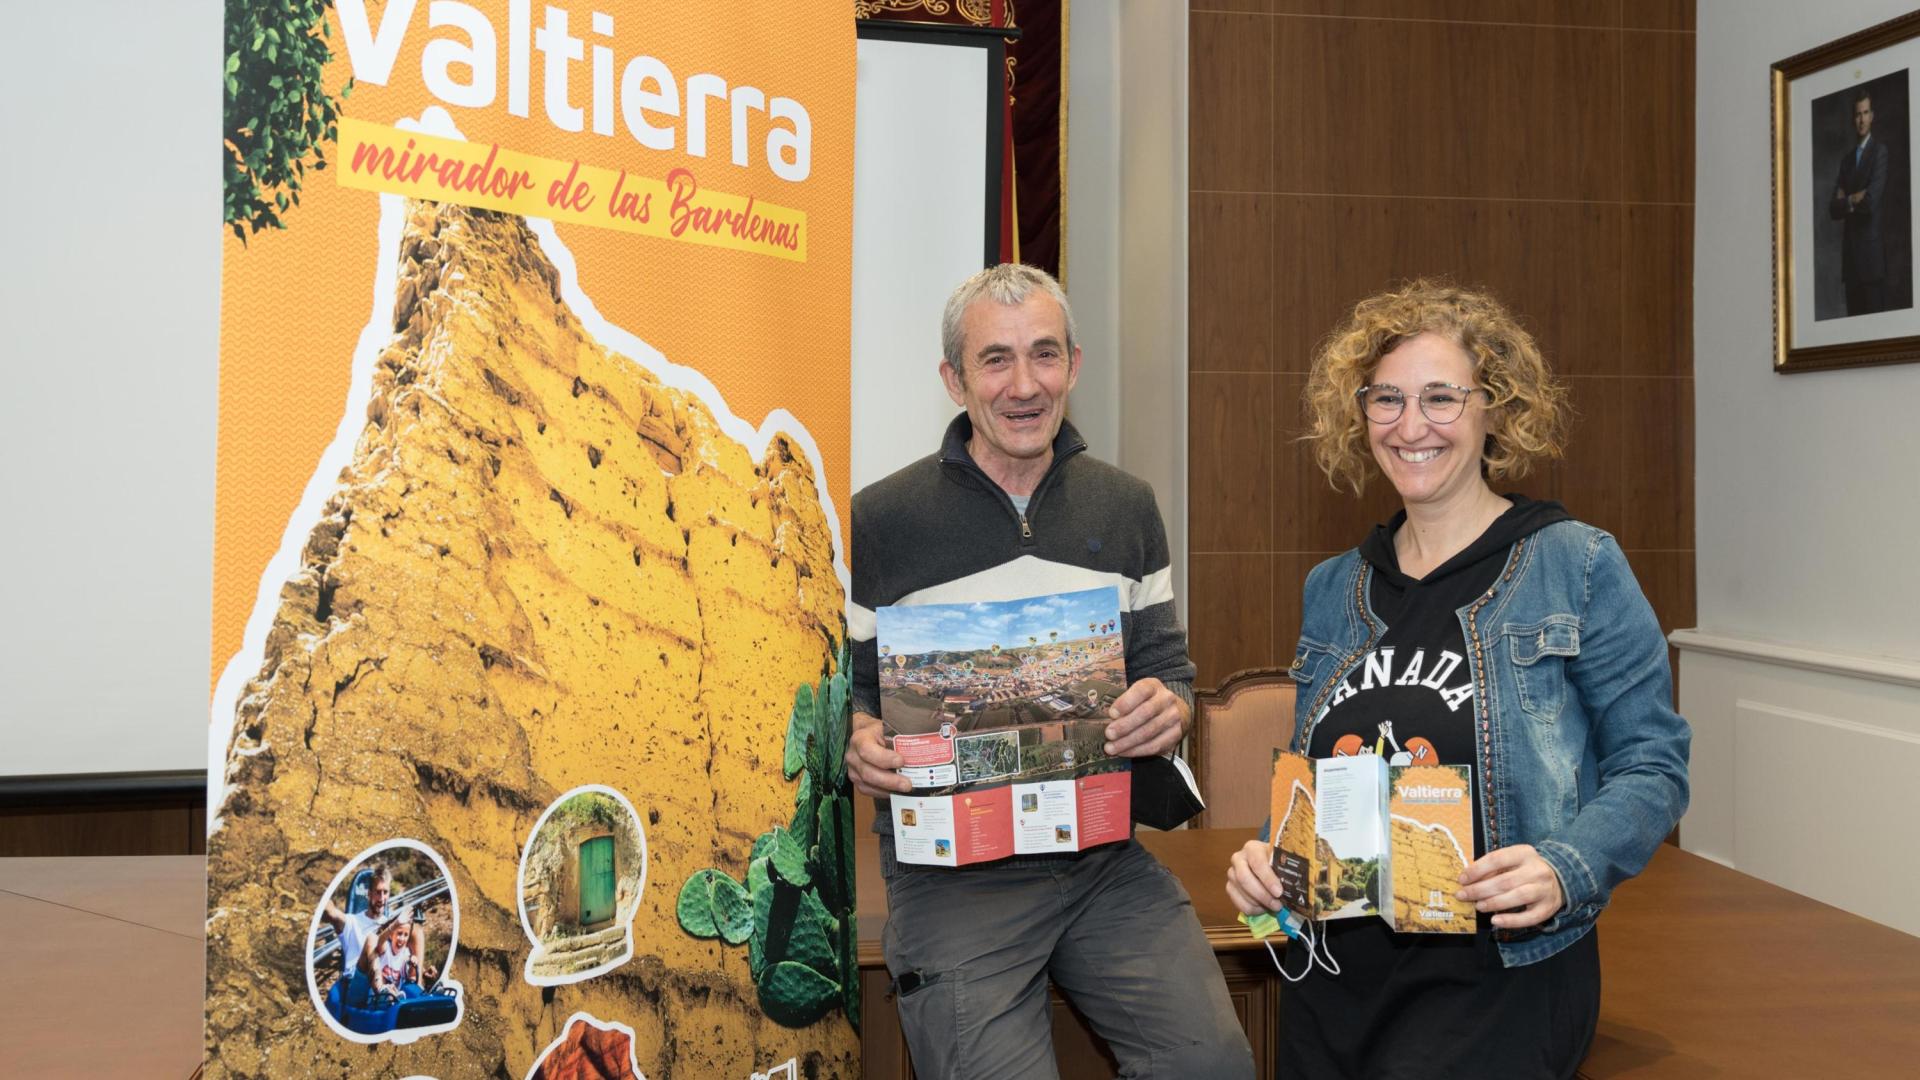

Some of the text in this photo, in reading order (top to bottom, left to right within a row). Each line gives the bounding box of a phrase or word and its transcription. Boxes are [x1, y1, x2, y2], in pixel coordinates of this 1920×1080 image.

[333, 0, 812, 183] Valtierra
[350, 138, 800, 251] mirador de las Bardenas
[1316, 648, 1474, 724] ANADA
[1398, 784, 1463, 799] Valtierra
